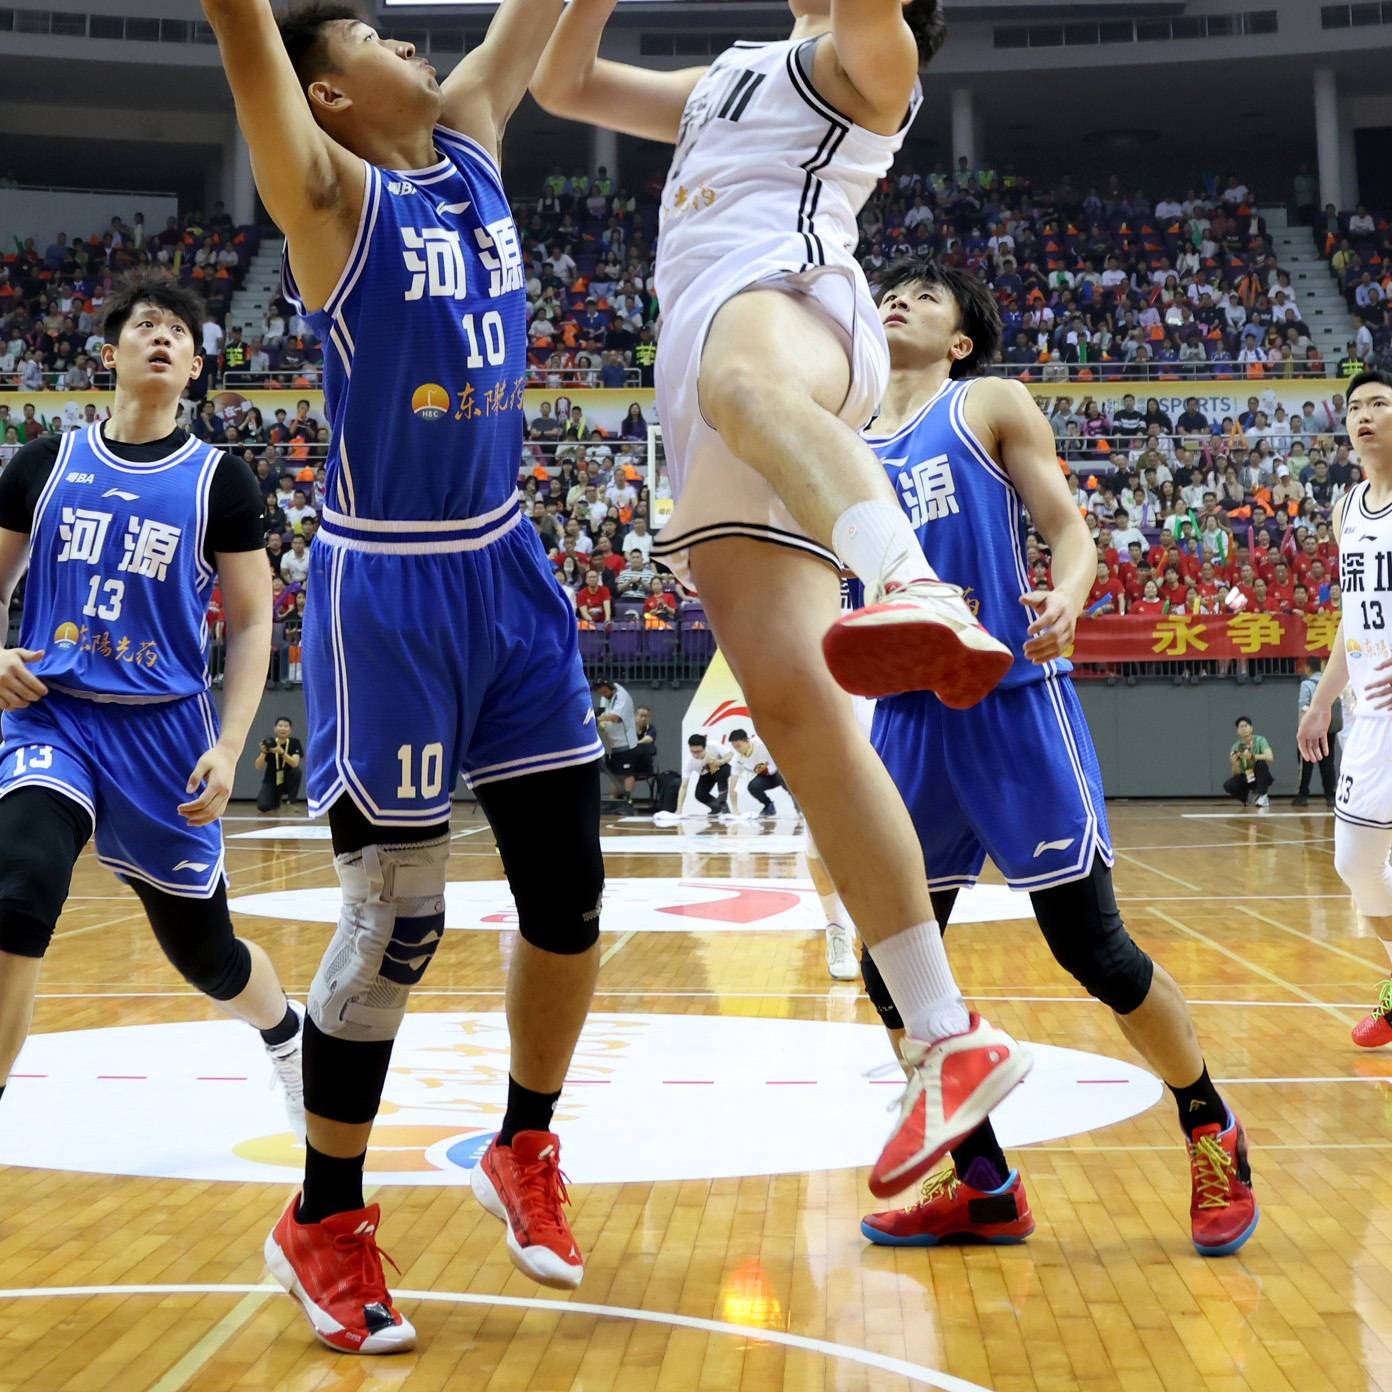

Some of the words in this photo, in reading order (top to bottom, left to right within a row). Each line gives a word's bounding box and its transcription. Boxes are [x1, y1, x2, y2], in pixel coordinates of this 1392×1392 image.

[400, 217, 524, 301] 河源
[462, 311, 505, 369] 10
[58, 507, 182, 582] 河源
[83, 574, 125, 622] 13
[1360, 600, 1385, 630] 13
[13, 745, 53, 776] 13
[397, 742, 444, 800] 10
